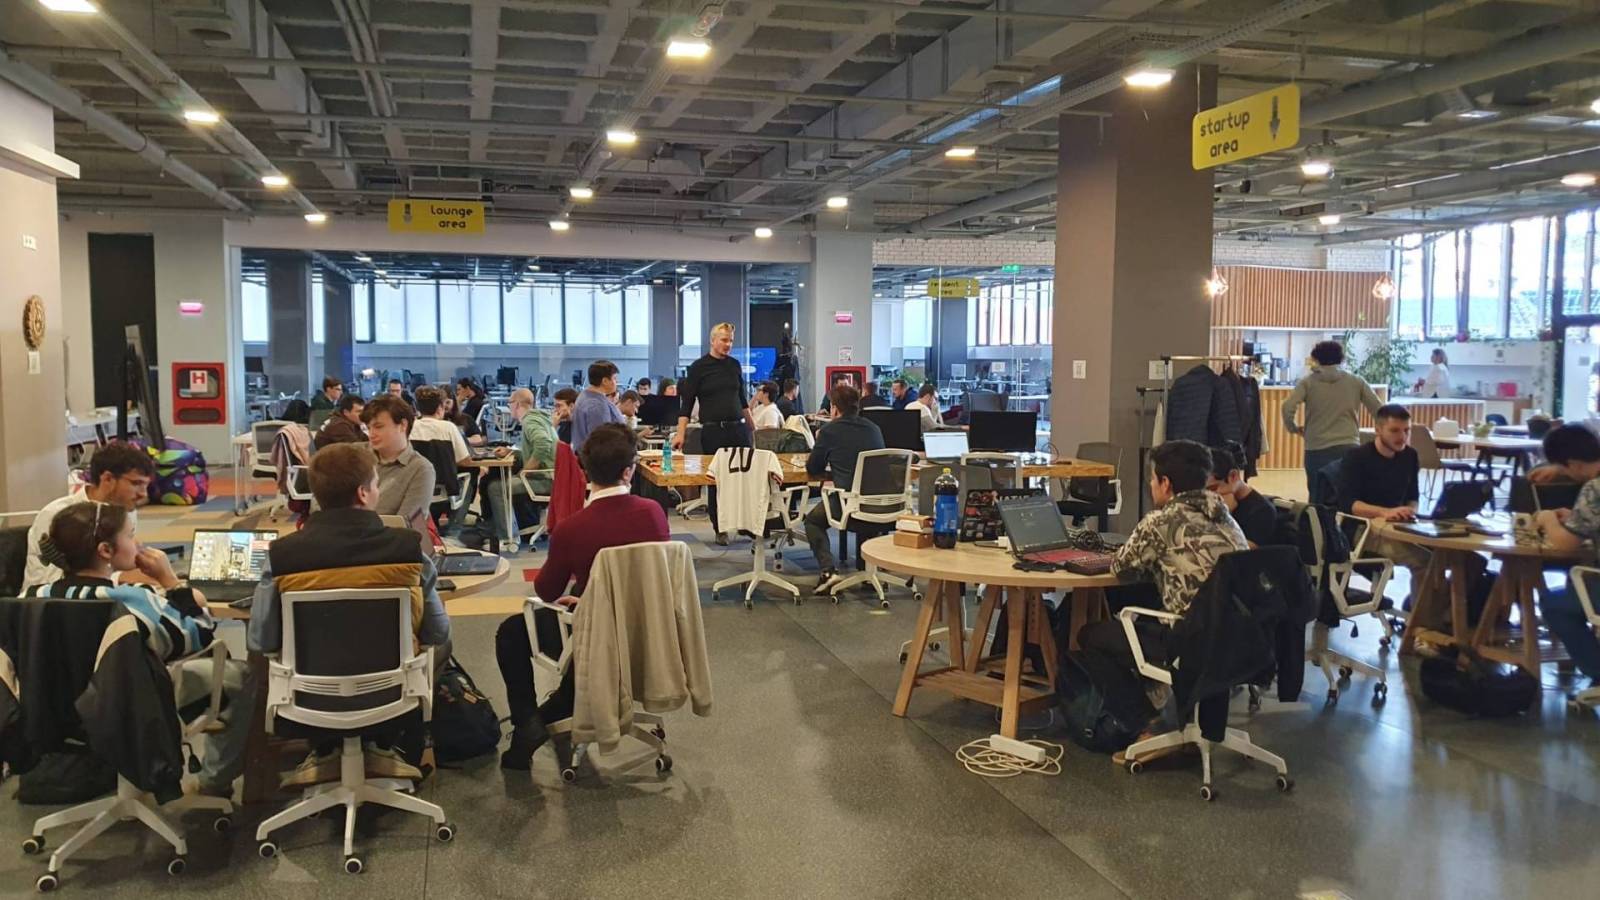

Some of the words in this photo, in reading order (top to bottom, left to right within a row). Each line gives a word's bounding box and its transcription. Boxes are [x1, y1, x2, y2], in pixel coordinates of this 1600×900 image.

[1200, 112, 1250, 137] startup
[1210, 140, 1239, 157] area
[438, 220, 467, 228] area
[192, 372, 205, 384] H
